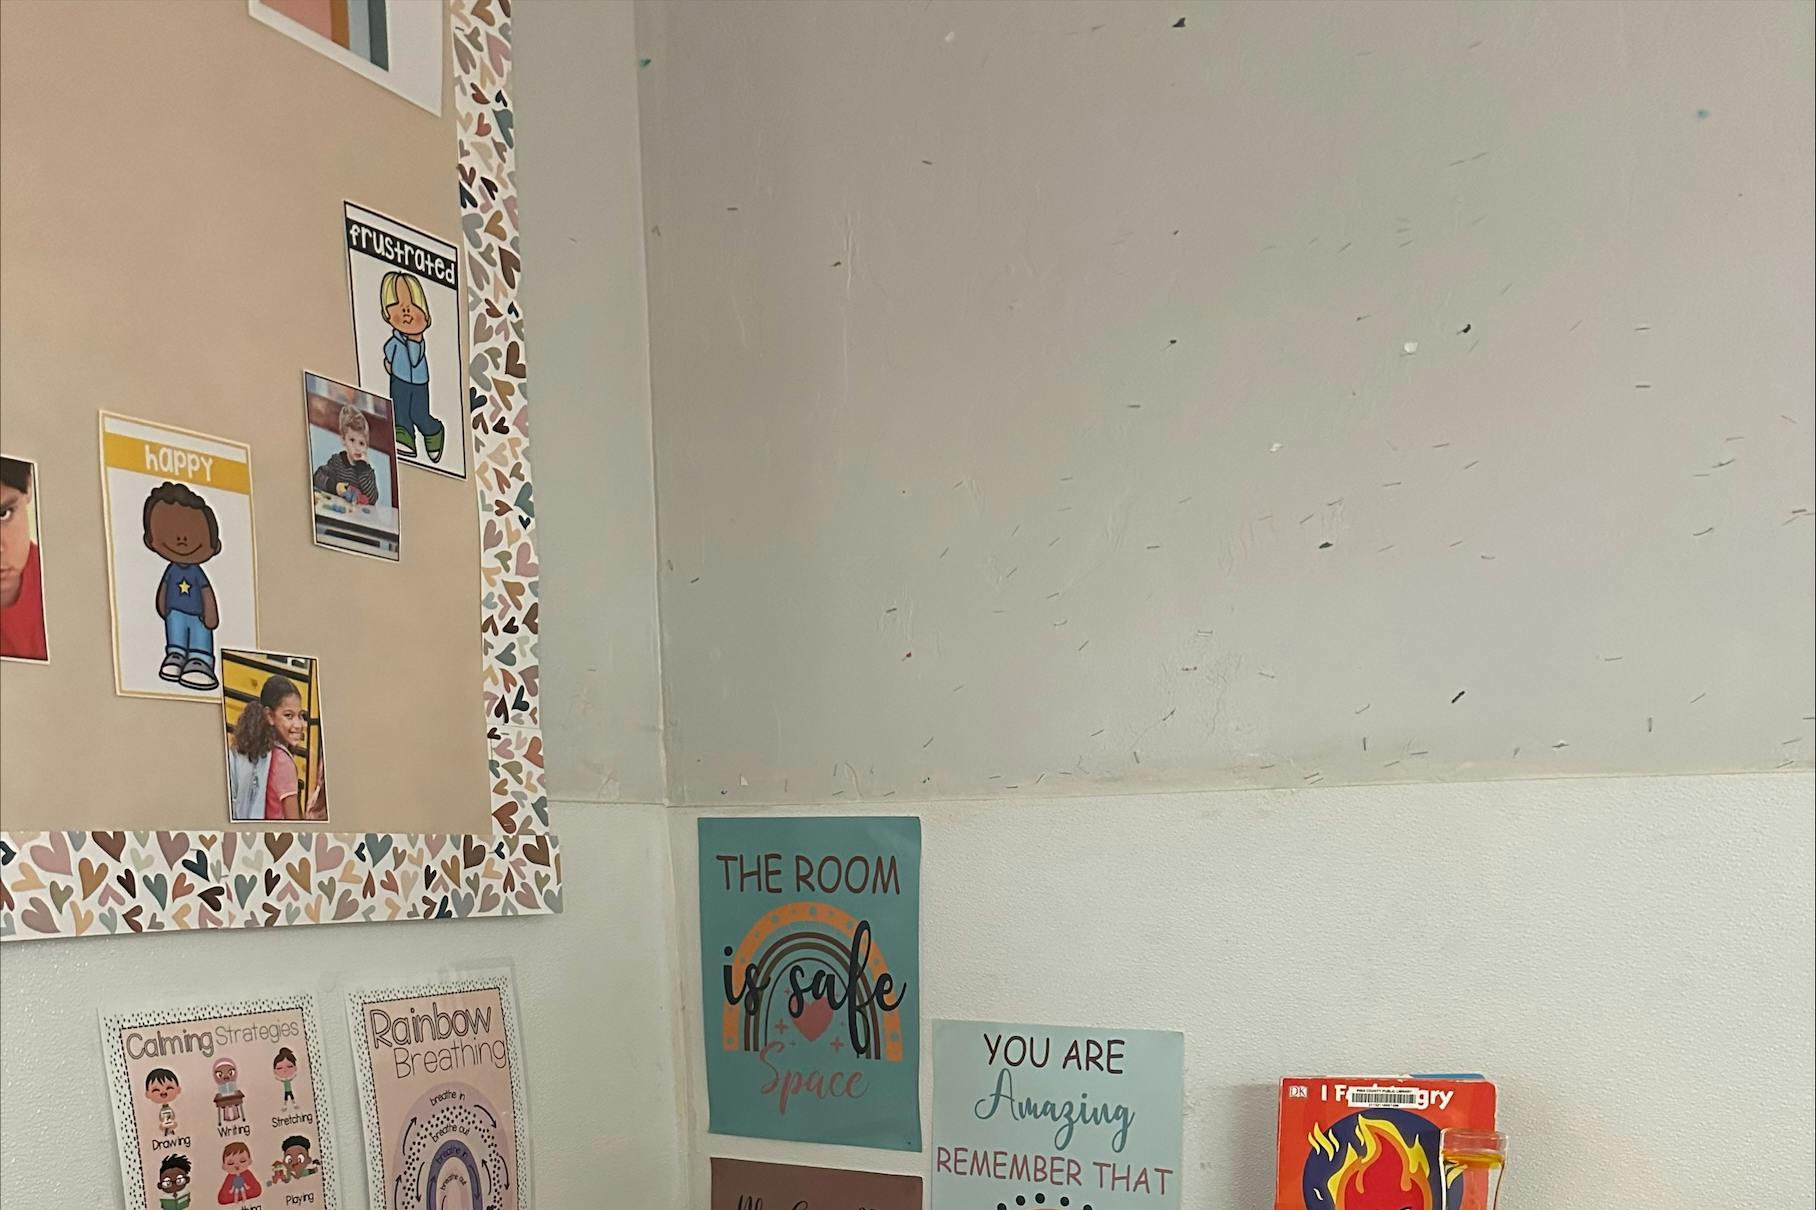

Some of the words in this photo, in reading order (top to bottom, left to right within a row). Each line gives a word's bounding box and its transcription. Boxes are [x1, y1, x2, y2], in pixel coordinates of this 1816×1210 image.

[349, 223, 455, 285] frustrated
[144, 443, 213, 482] happy
[716, 853, 782, 893] THE
[795, 854, 900, 895] ROOM
[723, 945, 771, 1016] is
[787, 920, 907, 1055] safe
[125, 1028, 217, 1061] Calming
[214, 1019, 301, 1048] Strategies
[369, 1002, 492, 1050] Rainbow
[393, 1036, 507, 1080] Breathing
[983, 1033, 1050, 1068] YOU
[1062, 1038, 1126, 1075] ARE
[429, 1089, 457, 1106] breathe
[459, 1090, 466, 1102] in
[759, 1040, 869, 1116] Space
[1289, 1086, 1308, 1098] DK
[217, 1123, 251, 1139] Writing
[271, 1112, 314, 1129] Stretching
[974, 1067, 1136, 1154] Amazing
[151, 1134, 192, 1152] Drawing
[430, 1123, 458, 1143] breathe
[458, 1125, 472, 1137] out
[936, 1146, 1083, 1187] REMEMBER
[1092, 1160, 1174, 1196] THAT
[285, 1190, 315, 1207] Playing
